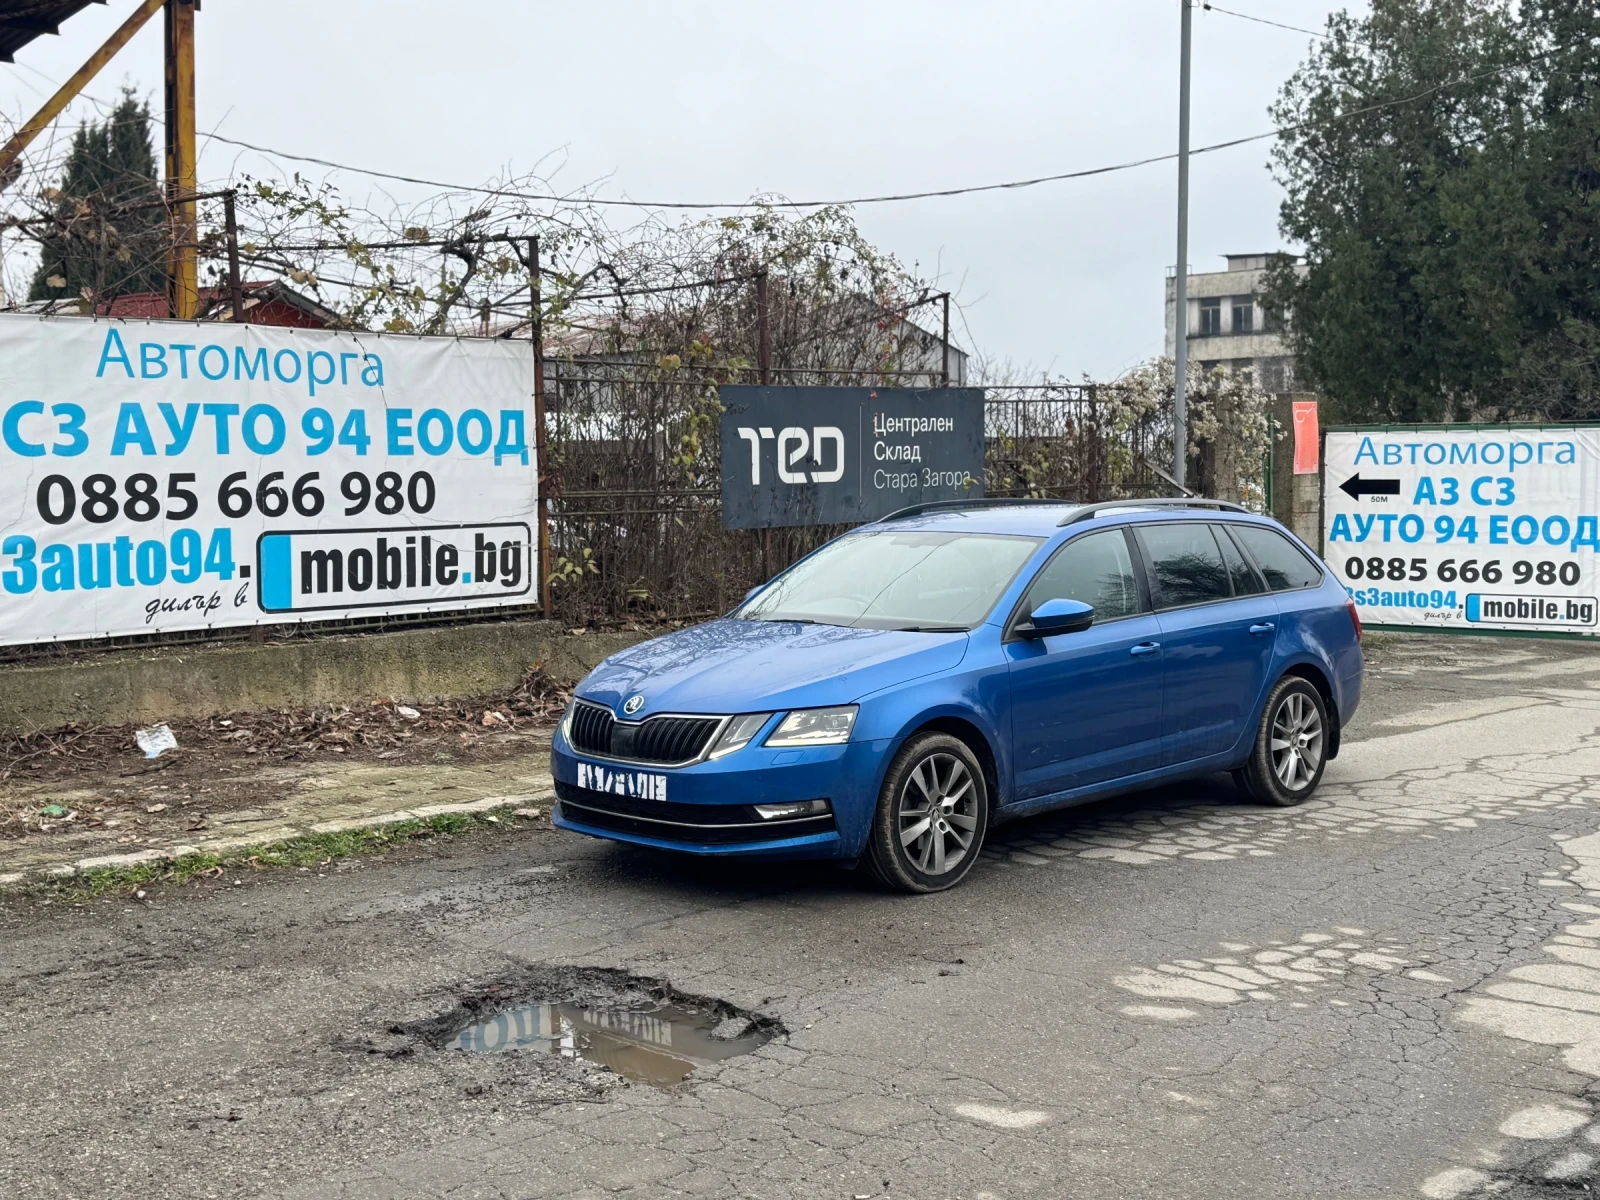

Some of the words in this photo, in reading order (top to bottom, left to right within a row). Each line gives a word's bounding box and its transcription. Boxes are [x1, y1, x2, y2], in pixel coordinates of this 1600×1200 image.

[96, 328, 385, 396] Автоморга
[110, 402, 286, 456] АУТО
[301, 407, 371, 456] 94
[386, 408, 529, 466] ЕООД
[873, 413, 953, 437] Централен
[874, 441, 921, 463] Склад
[1354, 437, 1575, 472] Автоморга
[37, 473, 198, 524] 0885
[217, 471, 324, 518] 666
[341, 470, 436, 516] 980
[874, 469, 917, 493] Стара
[923, 468, 970, 490] Загора
[1329, 514, 1425, 543] АУТО
[1434, 515, 1478, 544] 94
[1489, 515, 1600, 553] ЕООД
[301, 533, 521, 594] mobile.bg
[1345, 557, 1427, 581] 0885
[1437, 559, 1503, 583] 666
[1512, 561, 1581, 585] 980
[145, 590, 222, 624] дилър
[233, 582, 250, 608] в
[1484, 598, 1593, 623] mobile.bg
